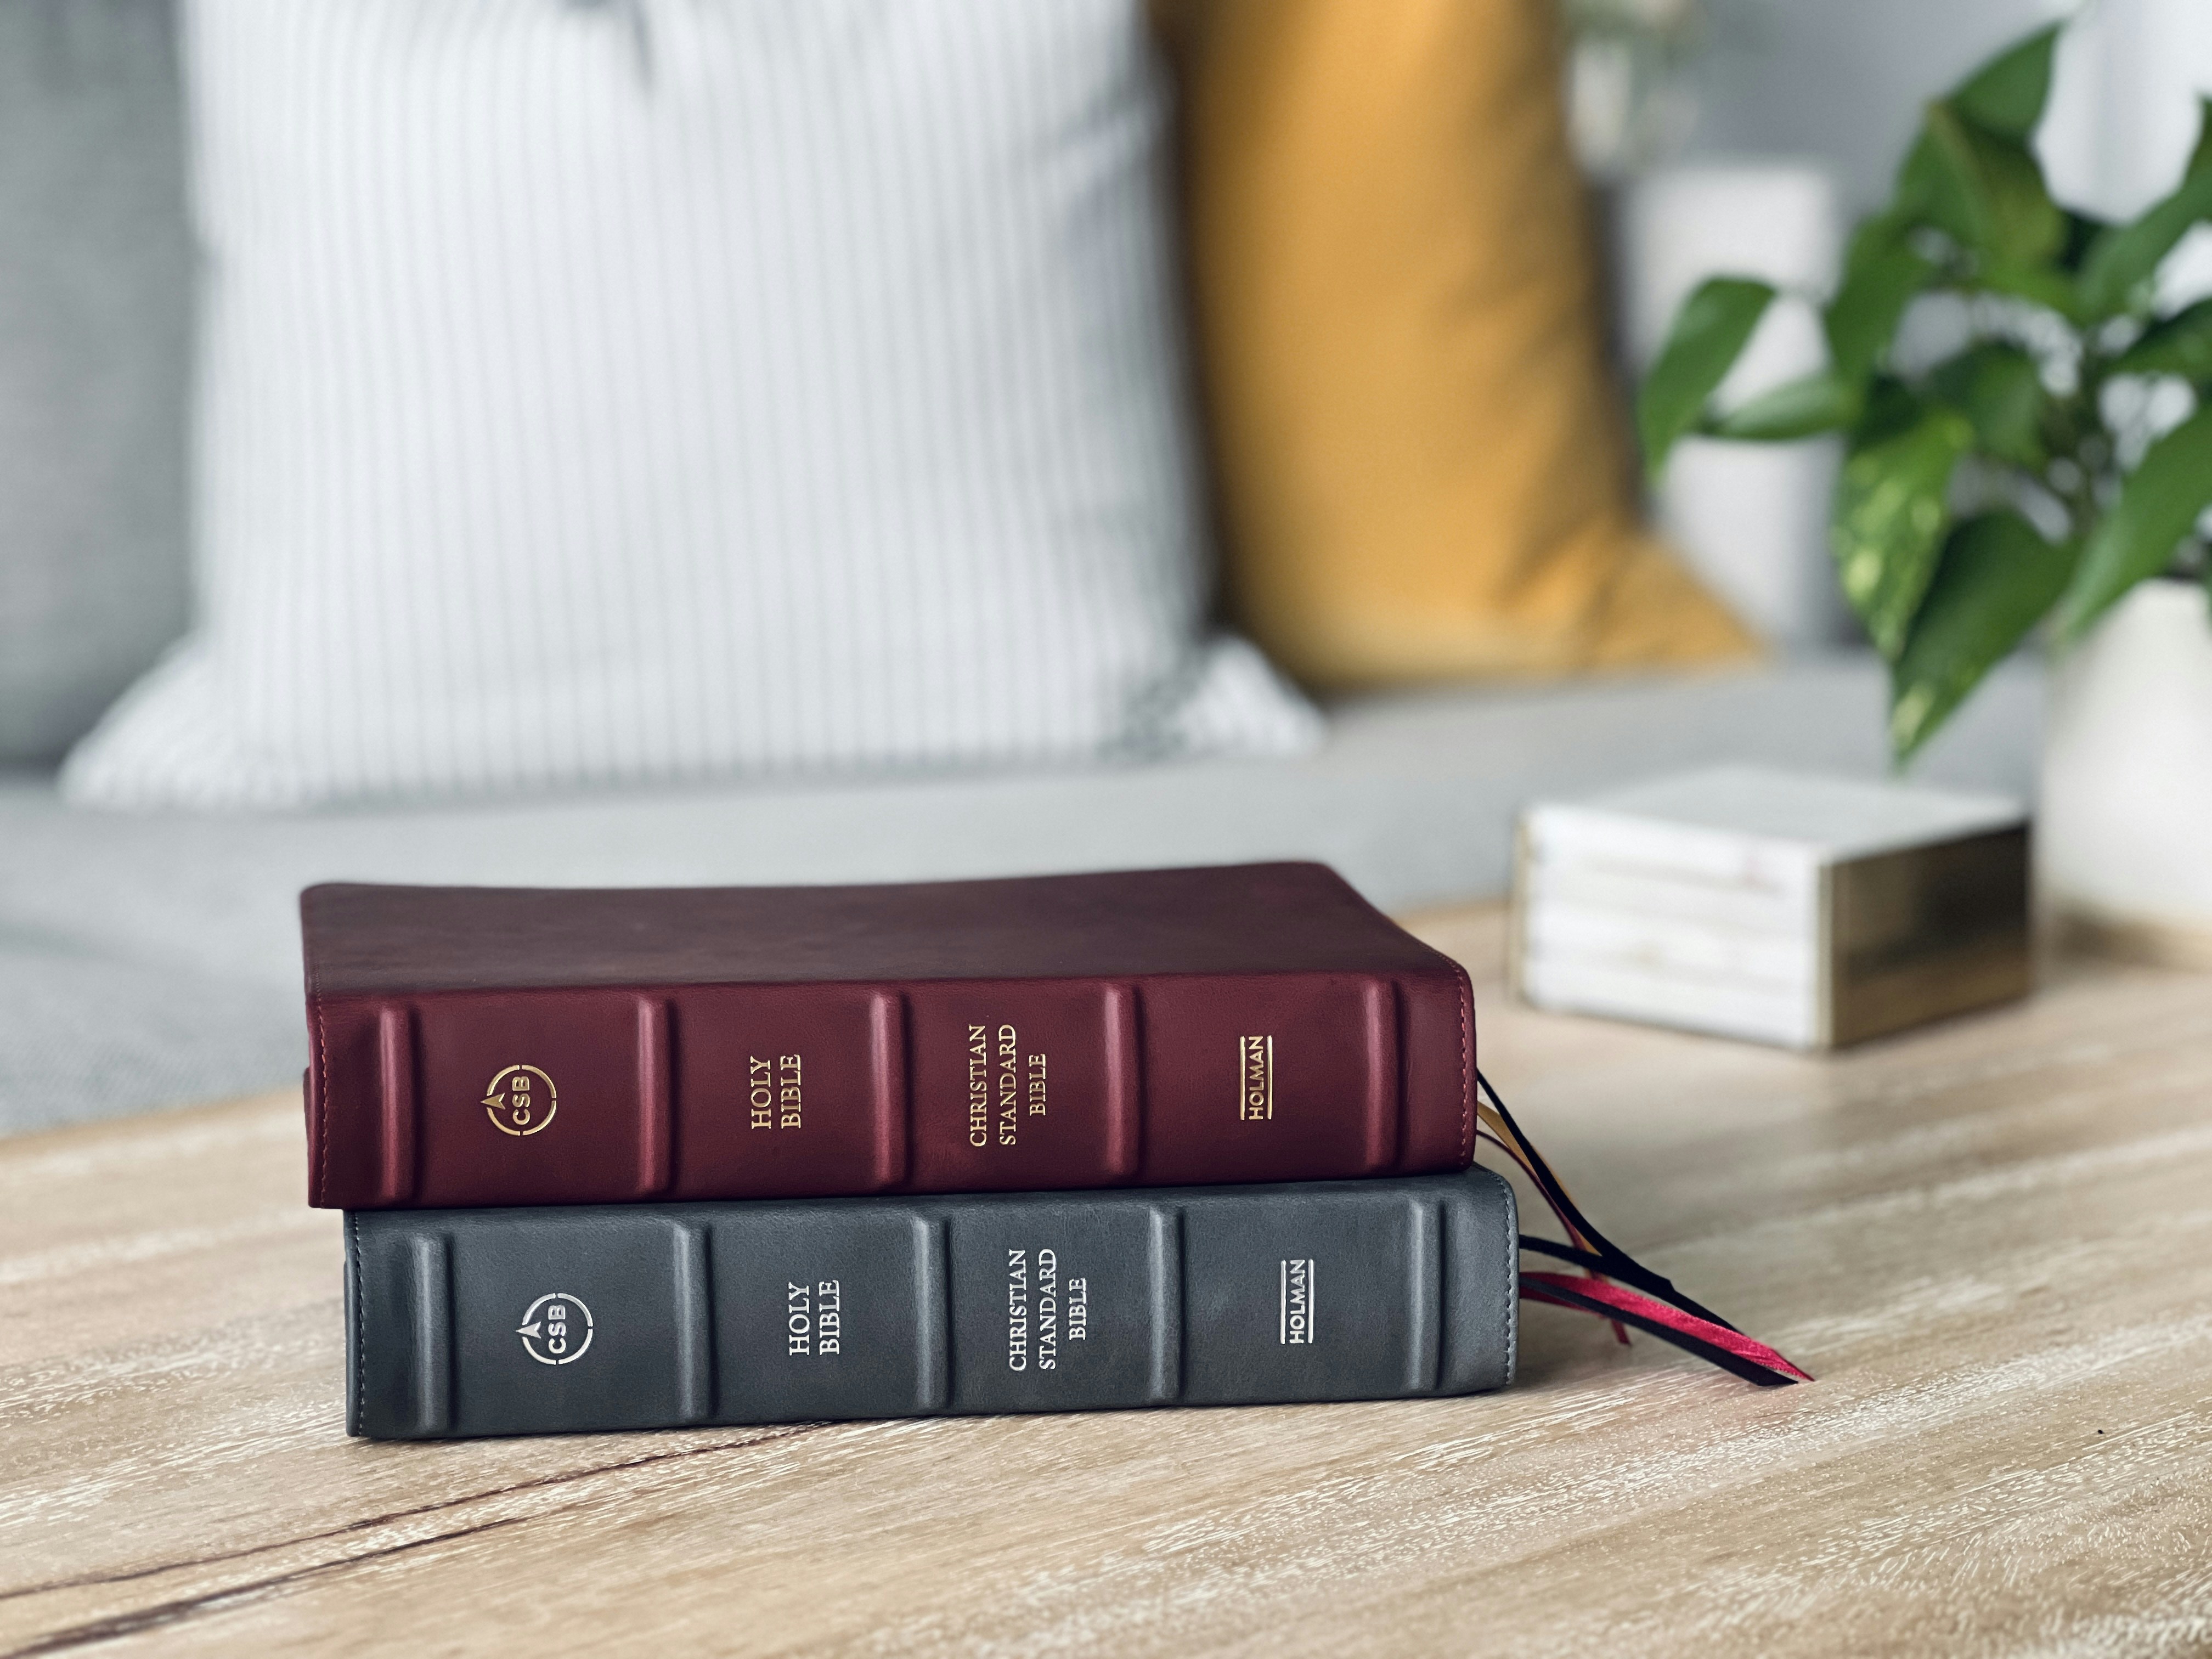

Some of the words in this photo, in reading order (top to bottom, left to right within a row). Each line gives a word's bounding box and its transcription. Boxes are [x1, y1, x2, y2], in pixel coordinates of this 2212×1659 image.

[512, 1076, 531, 1125] CSB
[750, 1056, 771, 1130] HOLY
[780, 1054, 802, 1129] BIBLE
[968, 1024, 987, 1147] CHRISTIAN
[998, 1024, 1017, 1145] STANDARD
[1029, 1053, 1046, 1116] BIBLE
[1248, 1035, 1264, 1120] HOLMAN
[548, 1305, 566, 1354] CSB
[788, 1281, 810, 1356] HOLY
[819, 1279, 840, 1356] BIBLE
[1008, 1249, 1027, 1371] CHRISTIAN
[1038, 1249, 1057, 1369] STANDARD
[1069, 1278, 1087, 1340] BIBLE
[1289, 1259, 1305, 1344] HOLMAN
